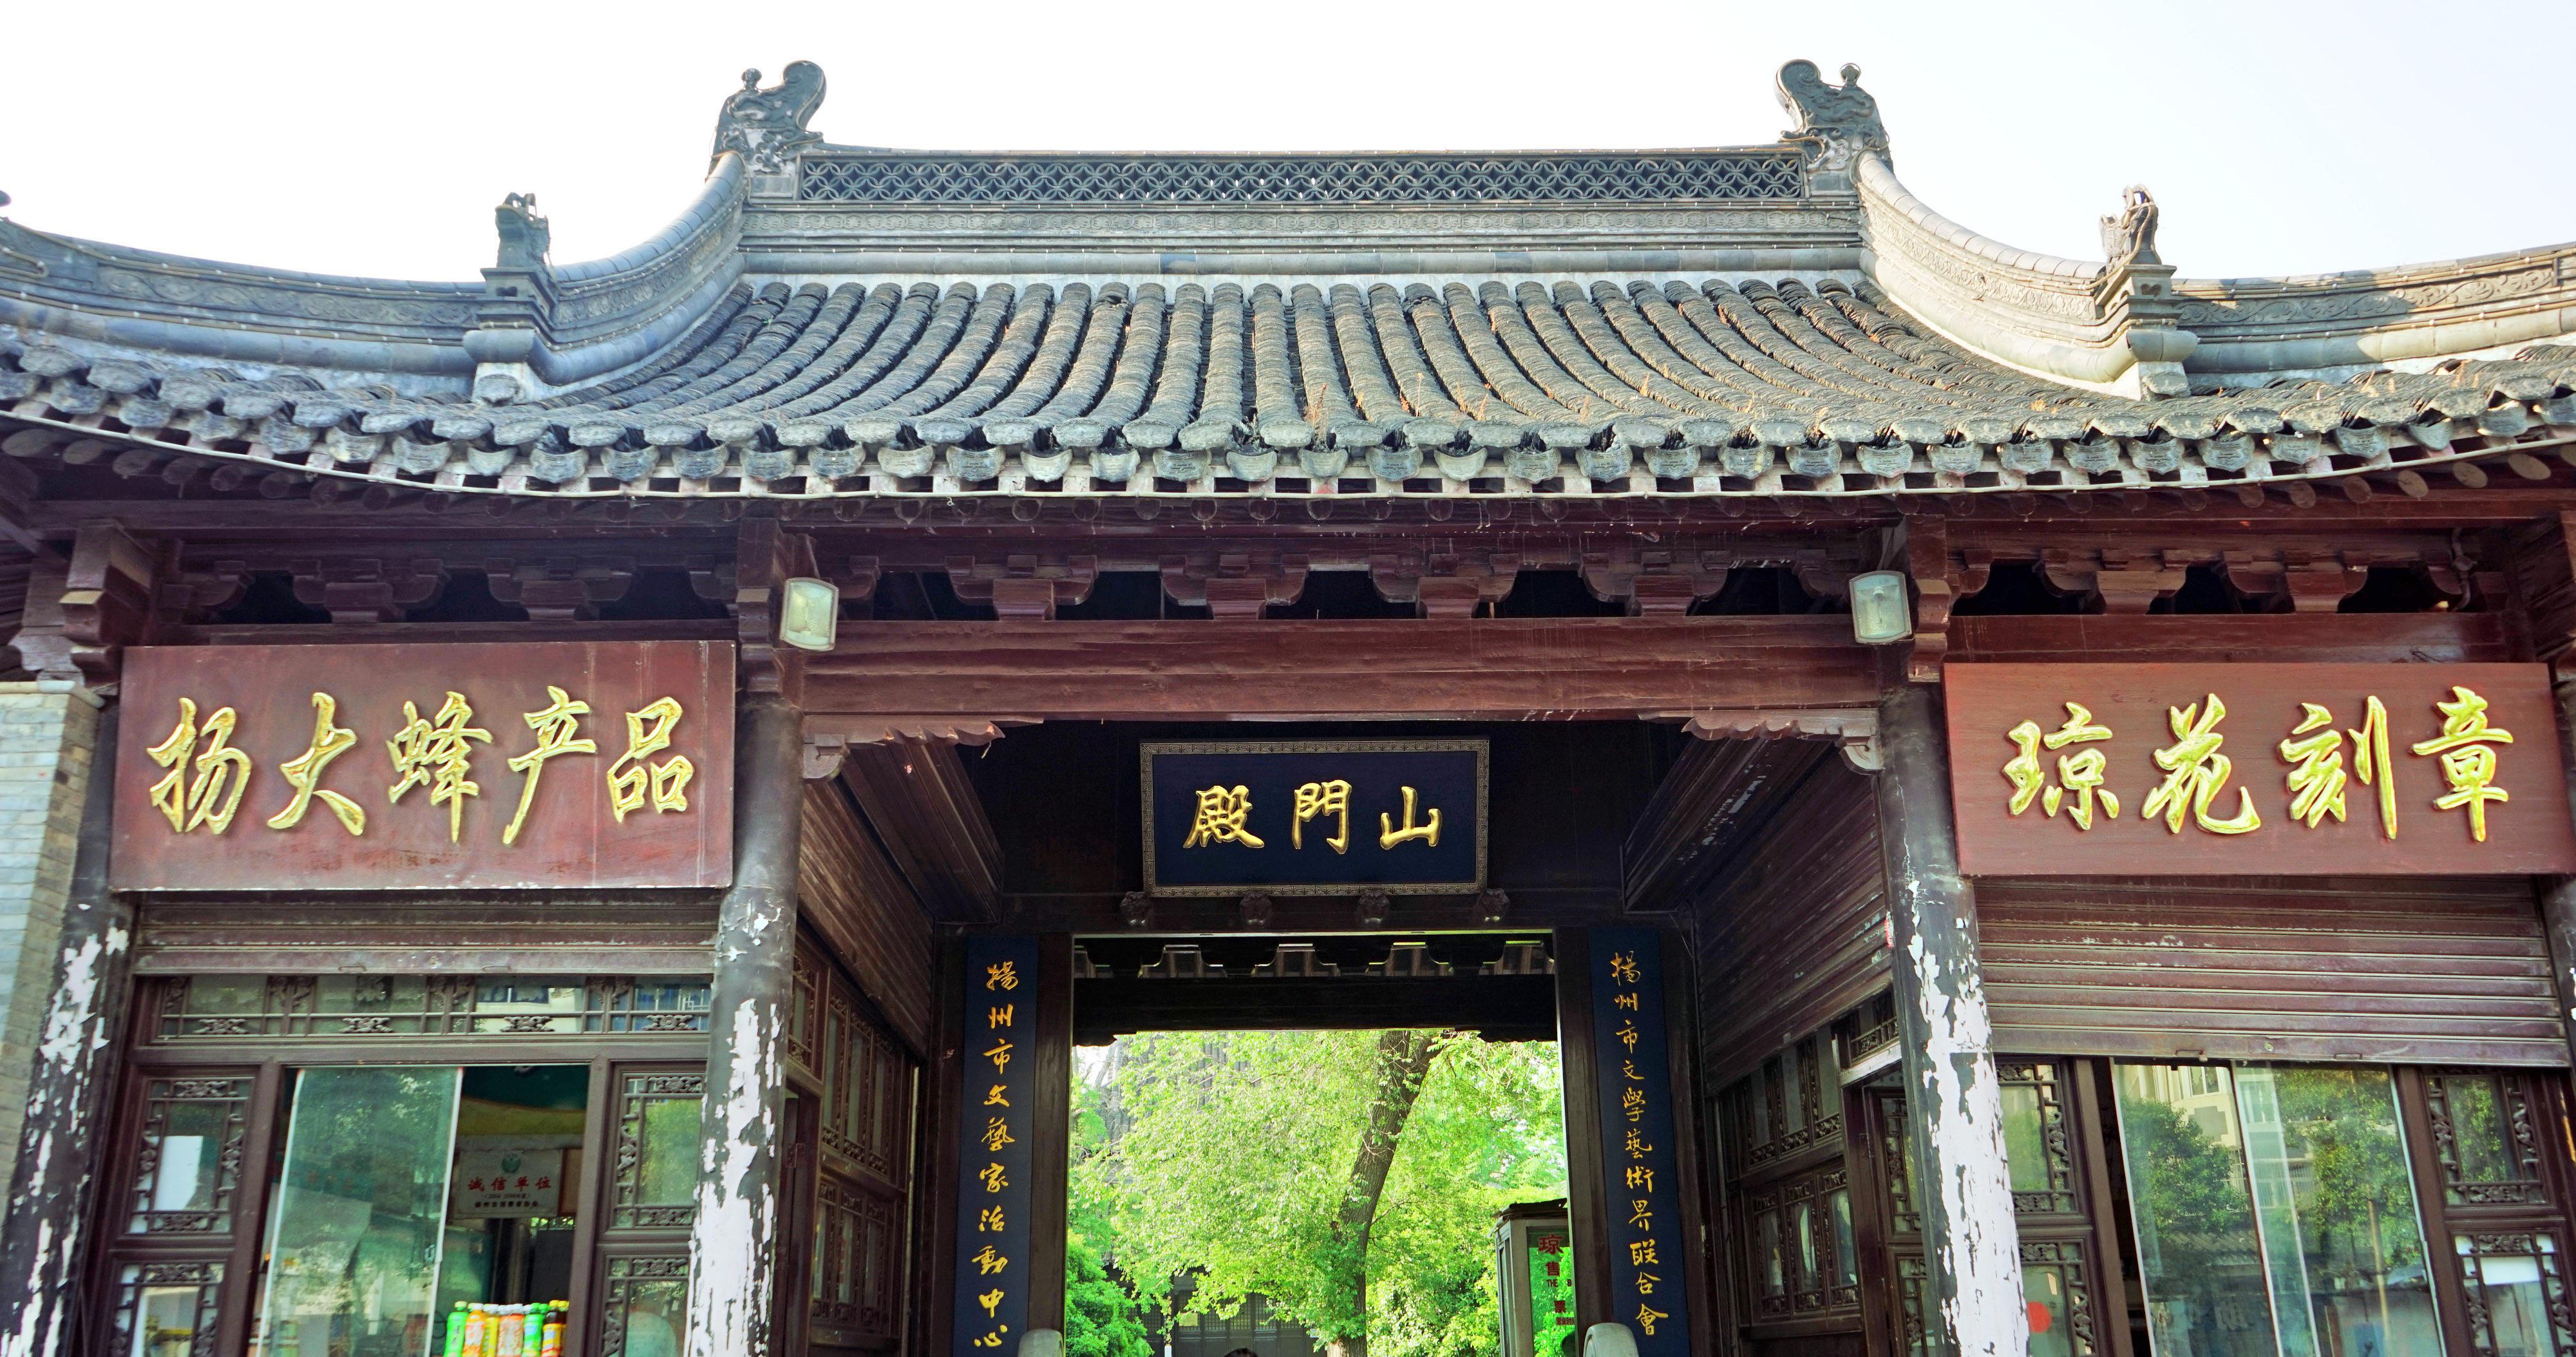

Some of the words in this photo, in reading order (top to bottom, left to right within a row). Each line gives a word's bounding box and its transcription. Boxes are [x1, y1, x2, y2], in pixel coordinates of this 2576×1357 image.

[146, 685, 694, 845] 扬大蜂产品
[2003, 685, 2515, 843] 琼花刻章
[468, 1175, 551, 1191] 诚信单位
[1538, 1234, 1564, 1255] 琼
[1546, 1261, 1560, 1276] 售
[1547, 1279, 1558, 1287] THE
